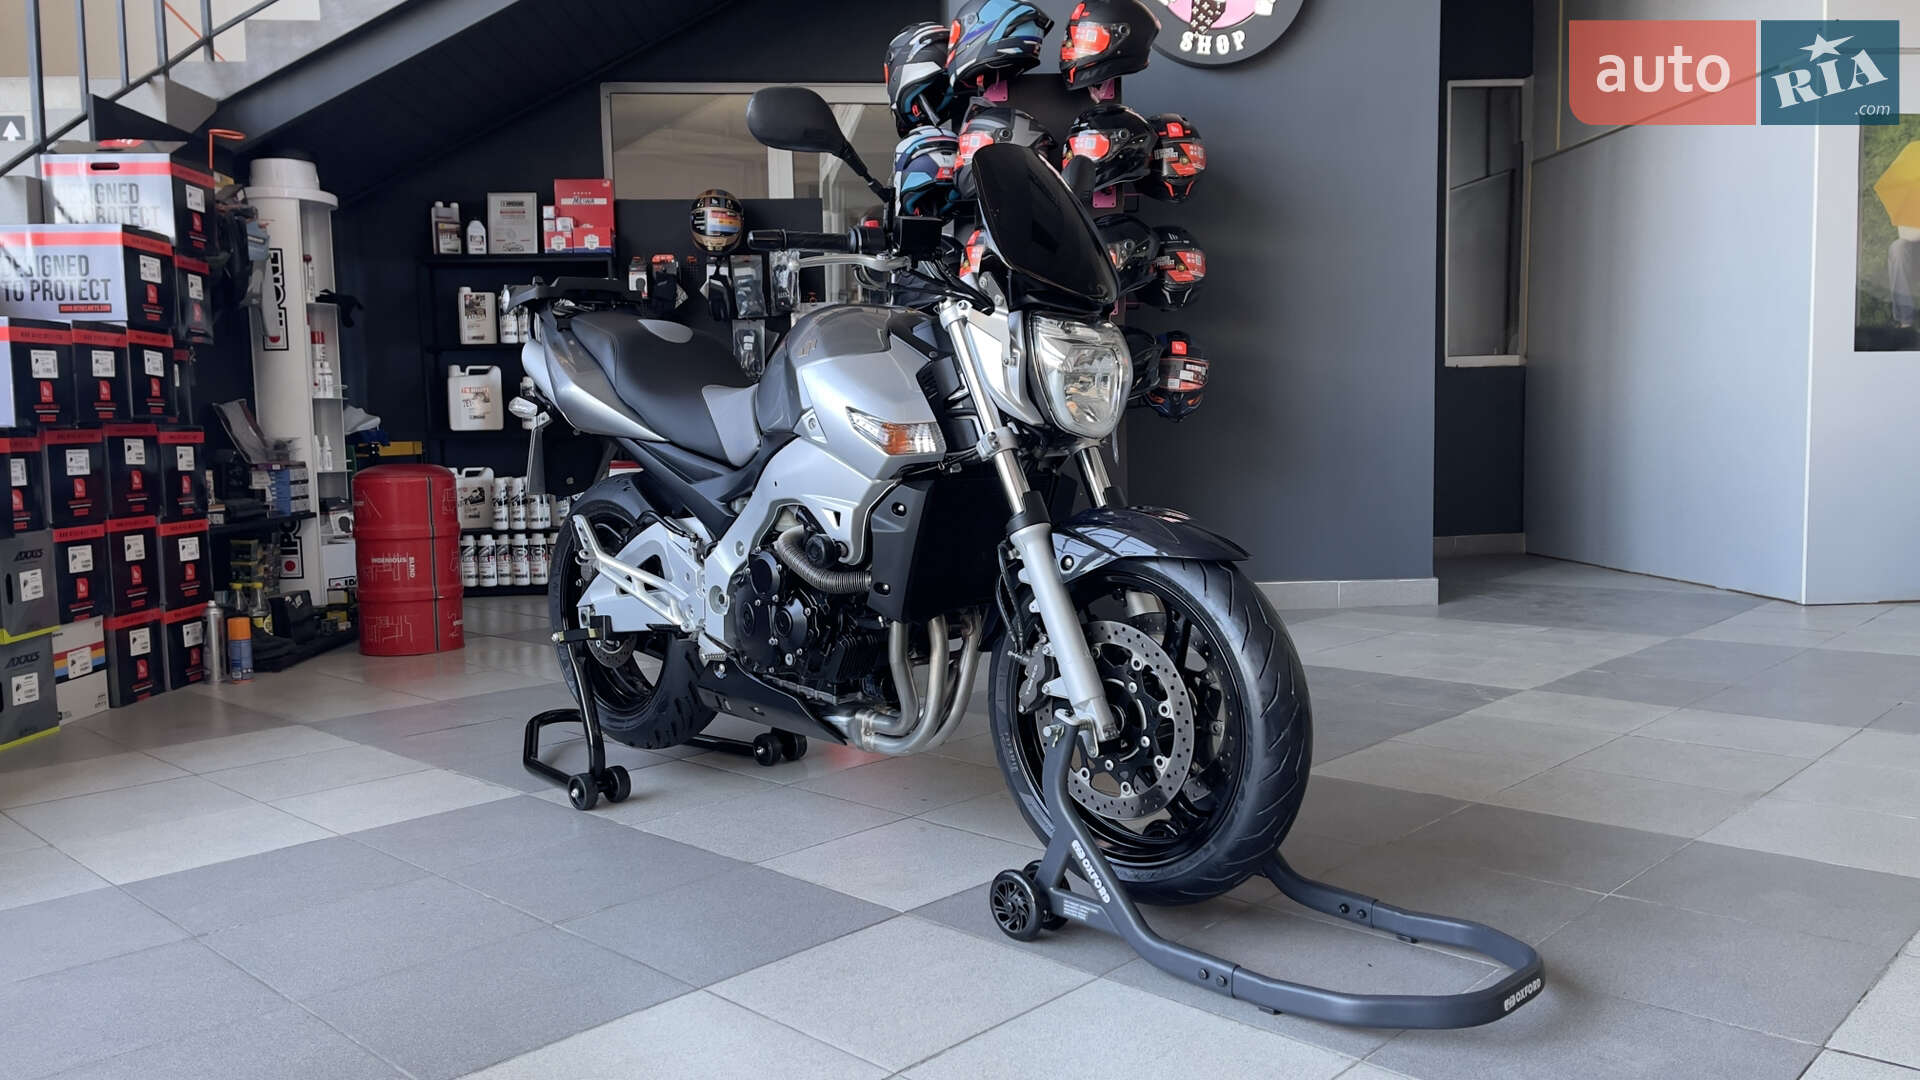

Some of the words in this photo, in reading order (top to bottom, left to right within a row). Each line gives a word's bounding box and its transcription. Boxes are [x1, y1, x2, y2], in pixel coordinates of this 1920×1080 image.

[1180, 30, 1246, 55] SHOP
[30, 278, 112, 302] PROTECT
[13, 549, 44, 563] AXXIS
[4, 651, 41, 670] AXXIS
[1082, 858, 1111, 904] OXFORD
[1515, 978, 1542, 1003] OXFORD
